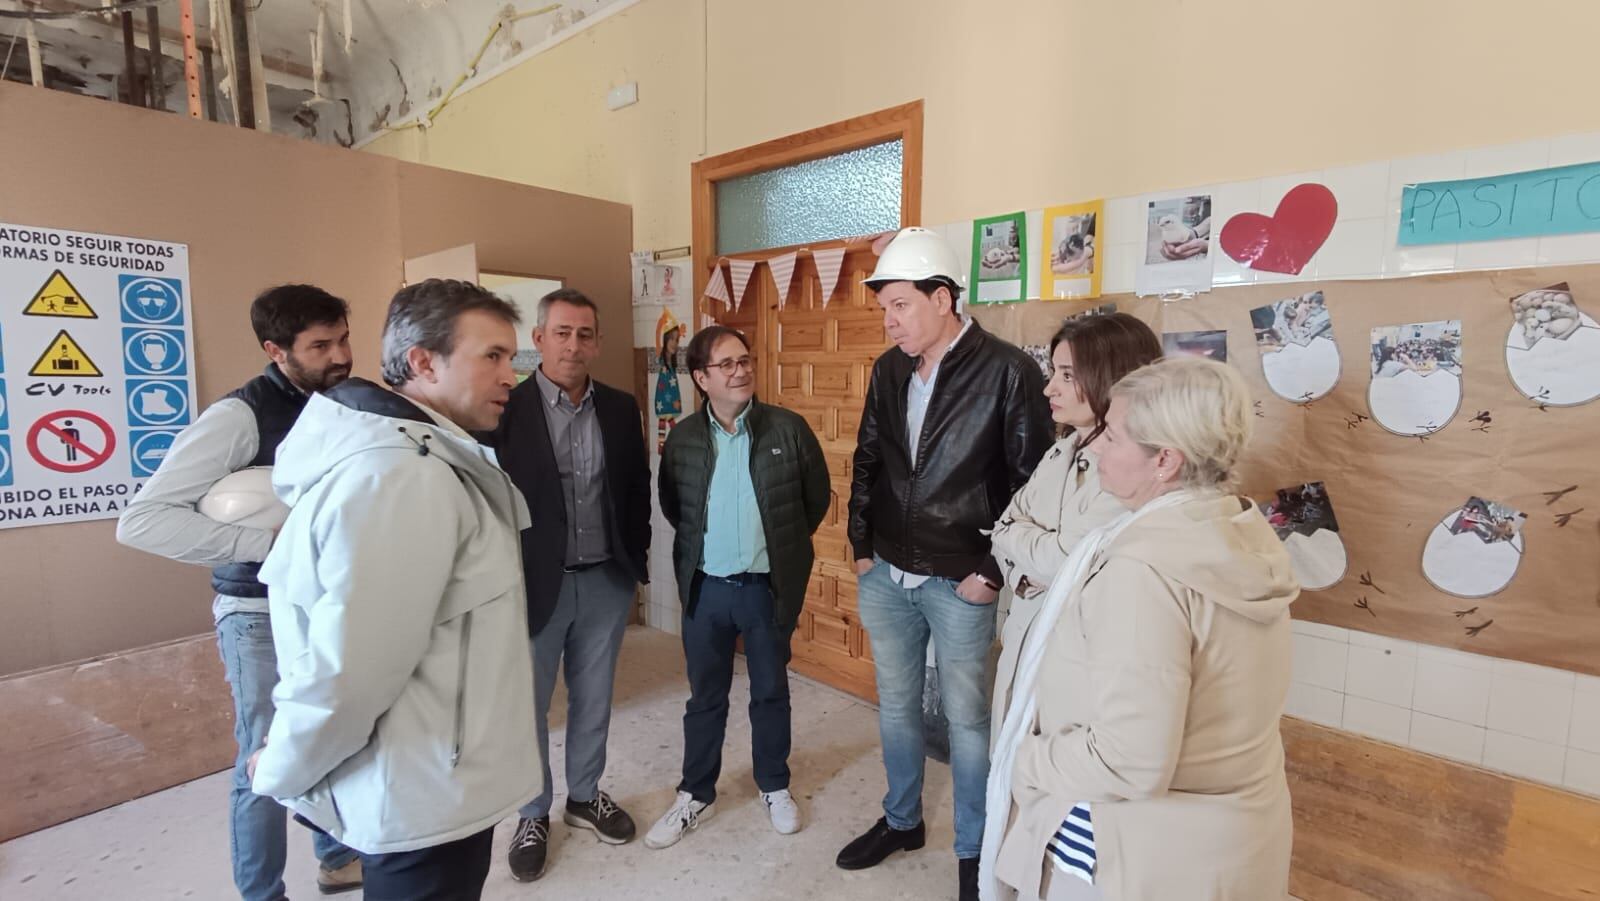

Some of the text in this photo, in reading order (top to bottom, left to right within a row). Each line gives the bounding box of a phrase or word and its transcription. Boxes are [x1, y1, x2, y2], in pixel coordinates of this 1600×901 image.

[0, 228, 174, 258] ATORIO SEGUIR TODAS
[0, 245, 165, 272] RMAS DE SEGURIDAD
[25, 382, 111, 396] CV Tools
[59, 487, 78, 499] EL
[83, 484, 128, 498] PASO
[134, 483, 143, 494] A
[43, 501, 101, 517] AJENA
[107, 500, 119, 512] A
